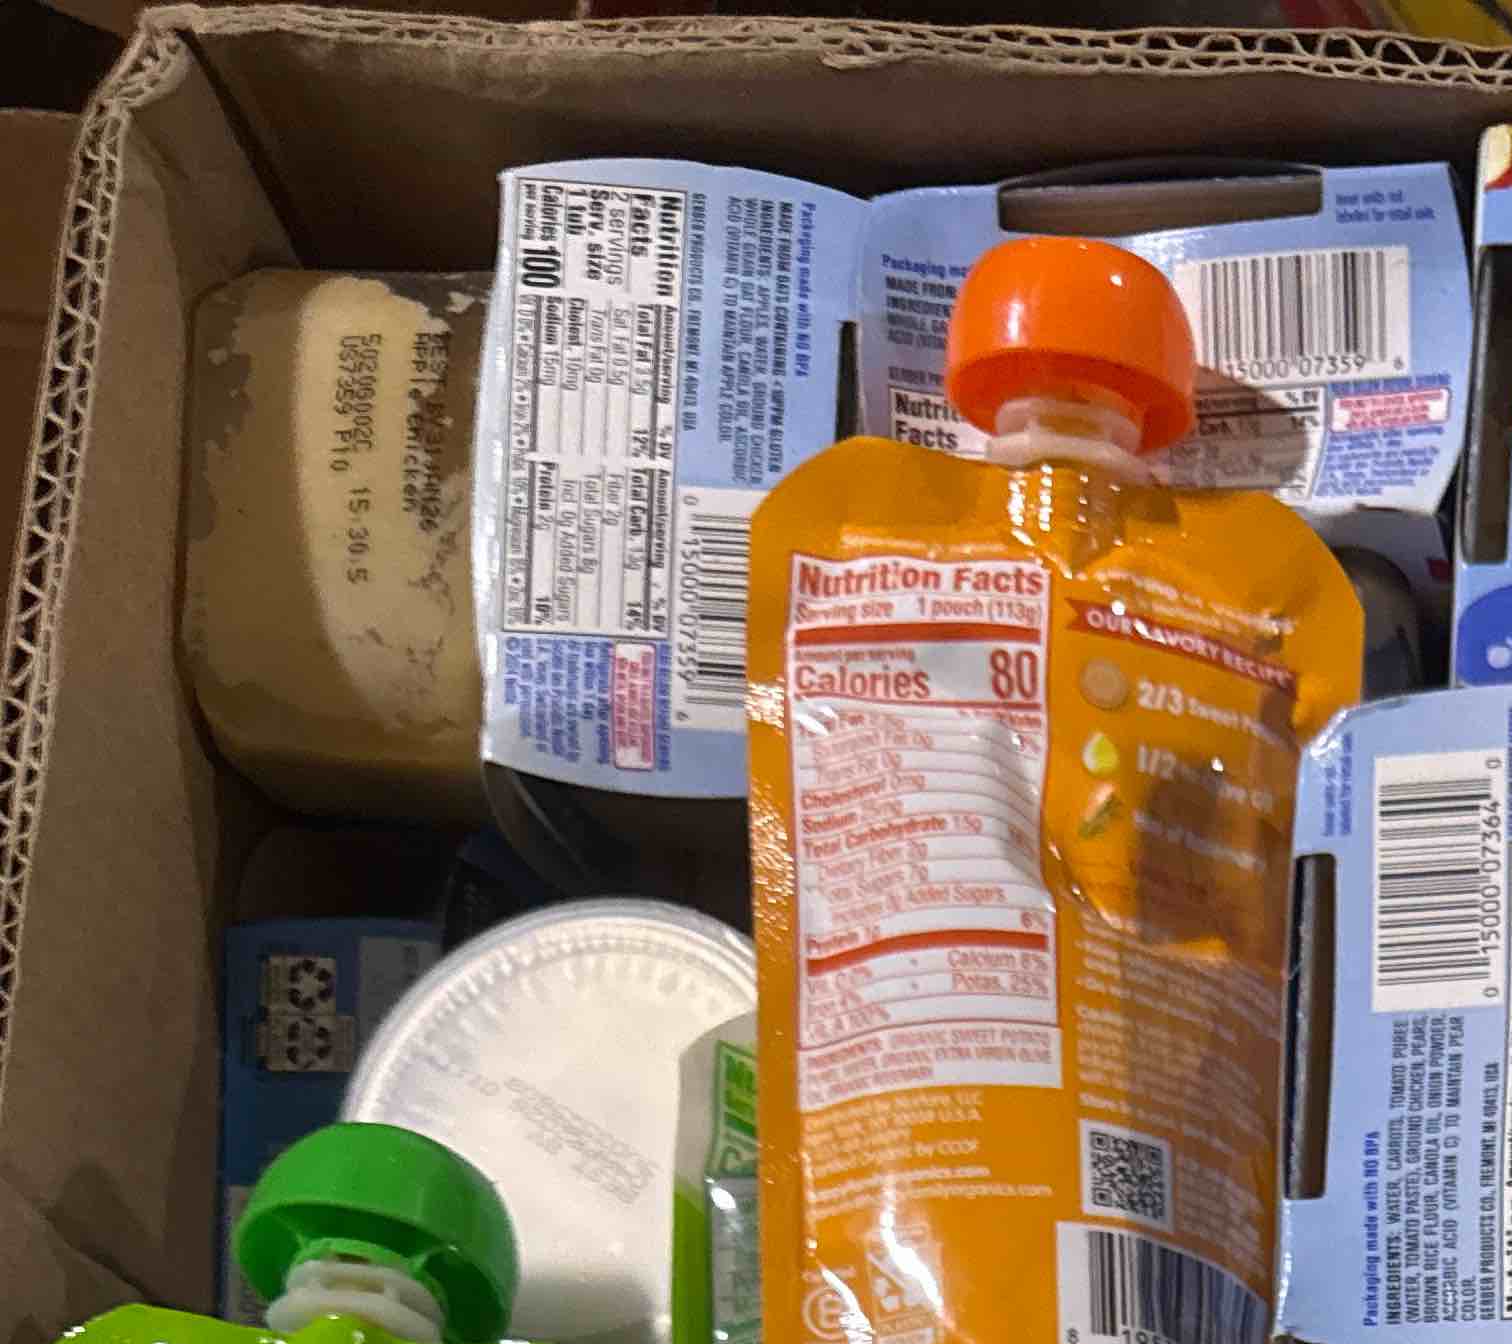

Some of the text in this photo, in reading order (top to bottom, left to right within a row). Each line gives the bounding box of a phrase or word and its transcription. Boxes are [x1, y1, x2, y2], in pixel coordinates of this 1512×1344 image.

[521, 184, 565, 287] Calories 100
[629, 192, 655, 257] Facts
[652, 194, 682, 298] Nutrition
[799, 560, 1044, 597] Nutrition Facts
[793, 652, 1039, 698] Calories 80
[1362, 1180, 1380, 1214] with
[1362, 1217, 1381, 1251] made
[1361, 1254, 1384, 1327] Packaging
